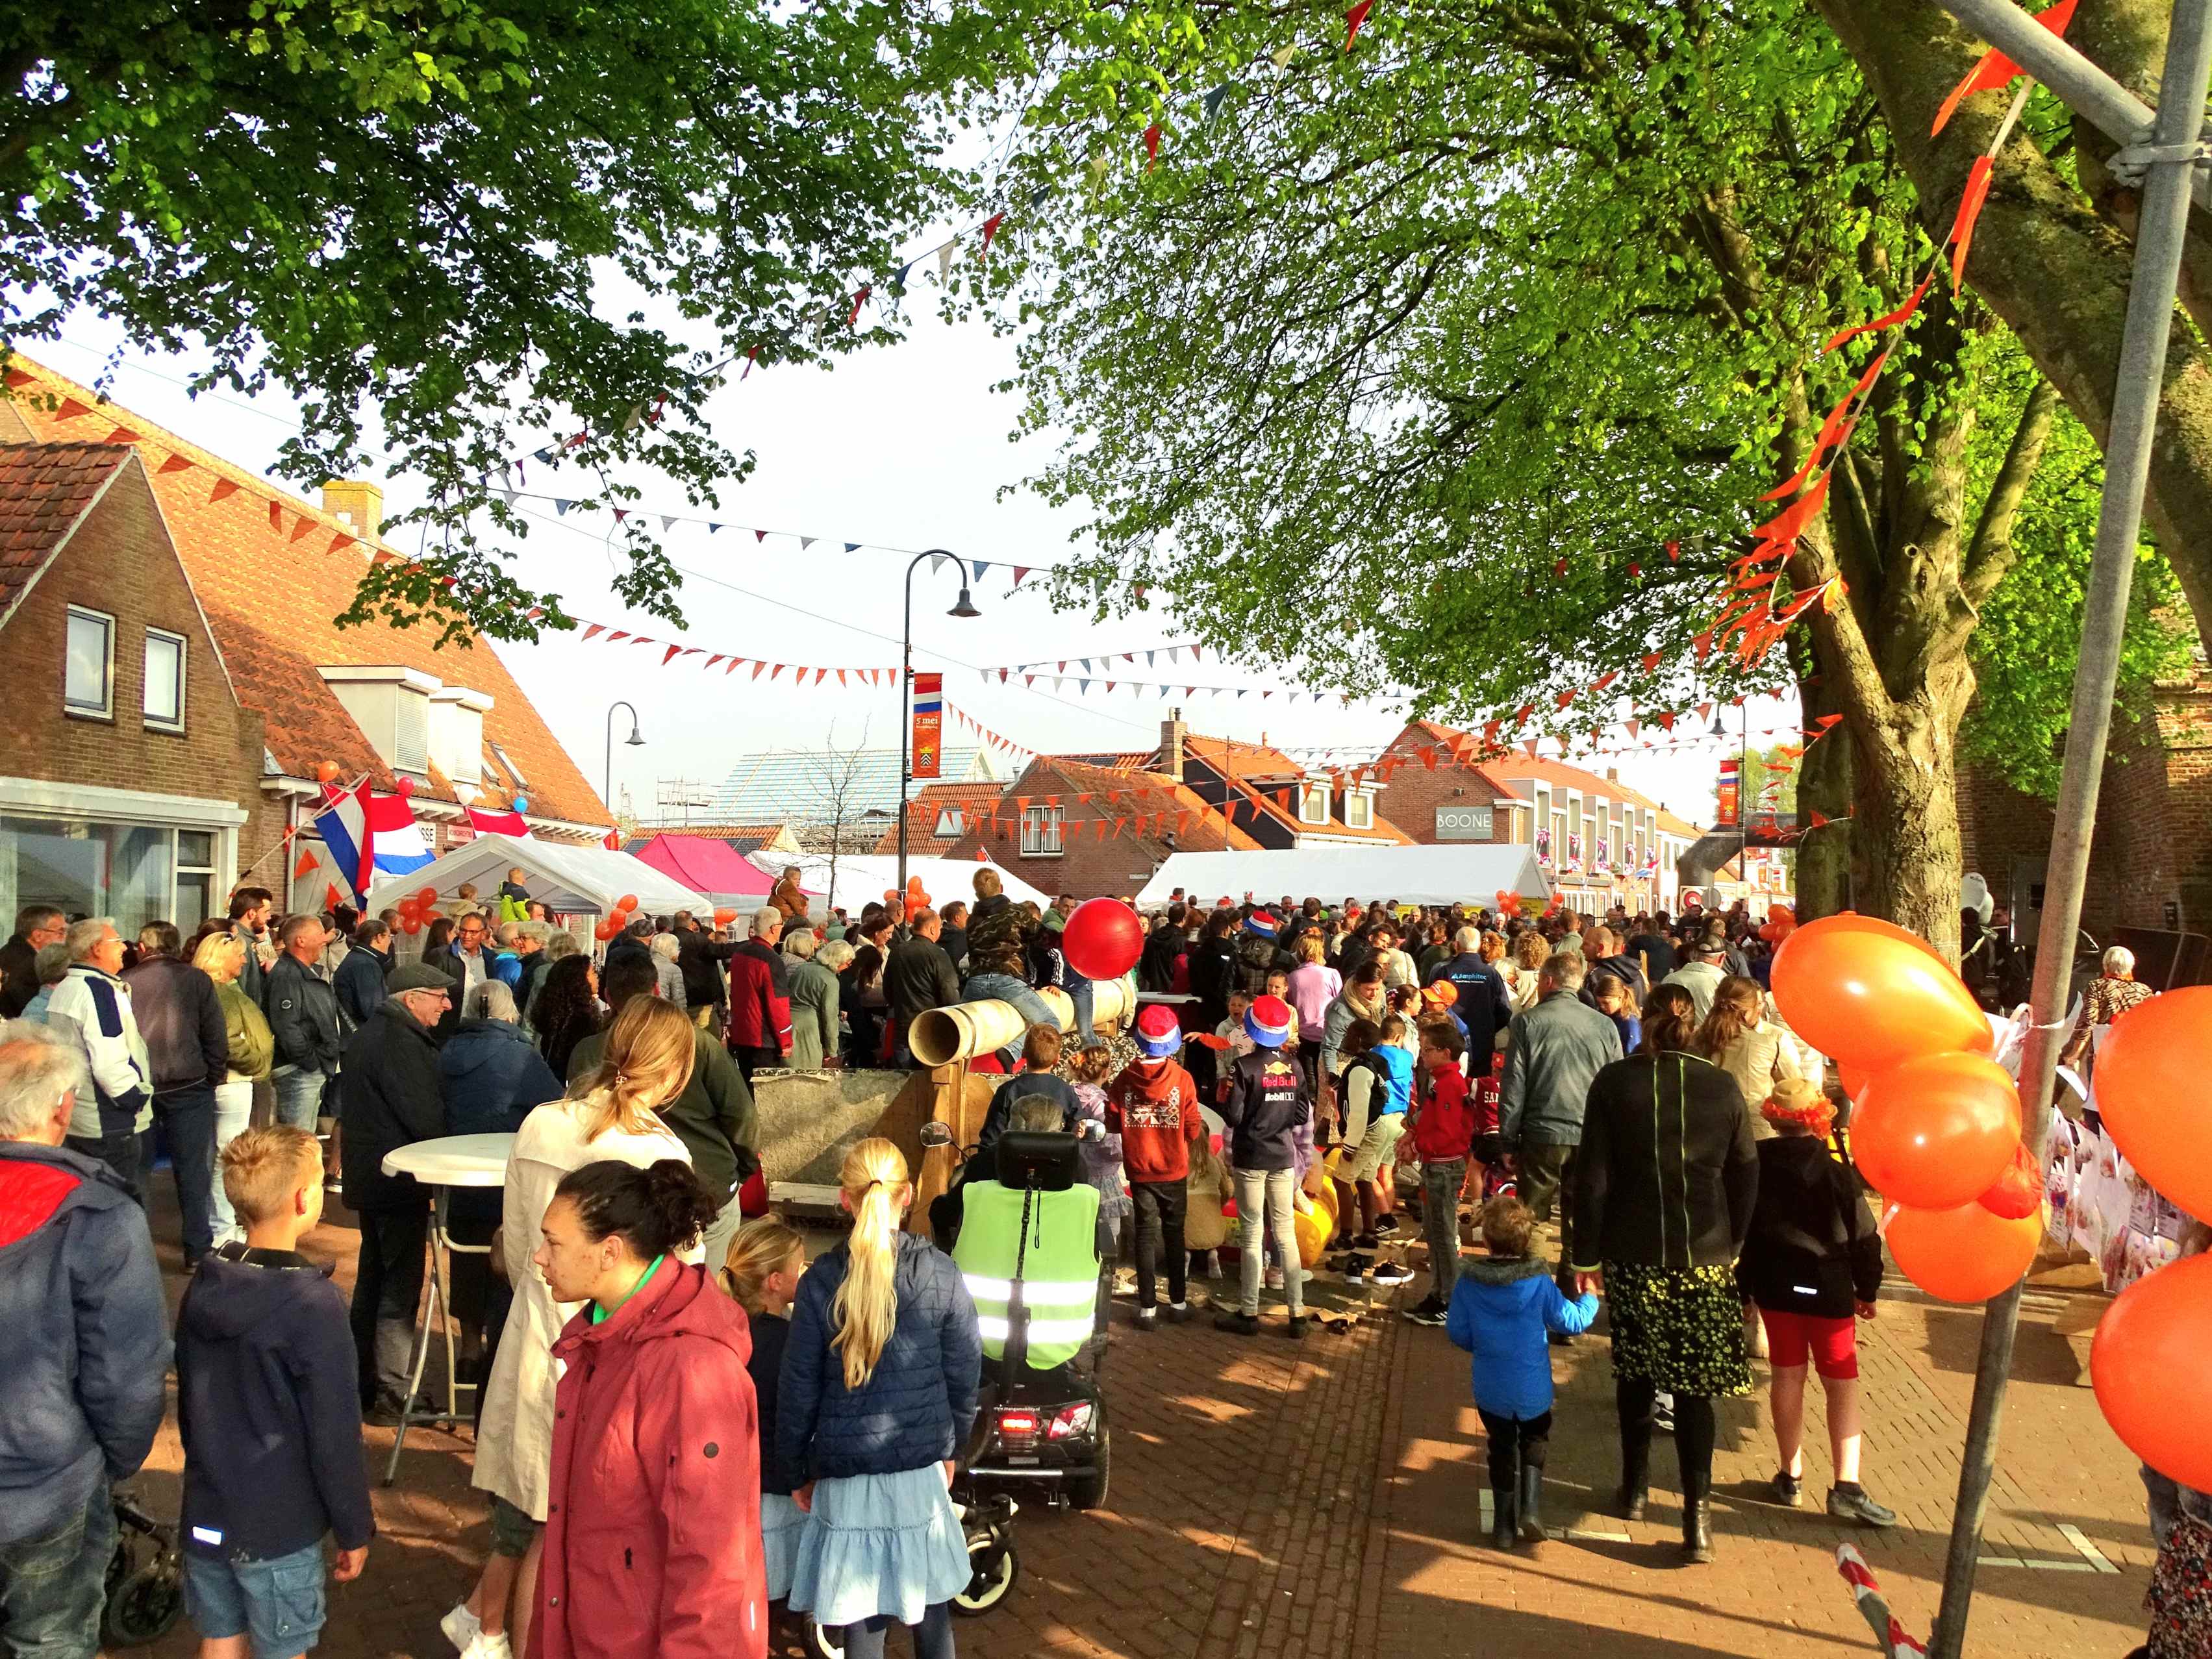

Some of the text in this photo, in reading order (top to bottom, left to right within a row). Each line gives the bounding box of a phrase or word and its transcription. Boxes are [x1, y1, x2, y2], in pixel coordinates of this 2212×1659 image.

[922, 716, 938, 724] mei
[1437, 814, 1492, 828] BOONE
[418, 827, 433, 842] SSE
[1263, 1075, 1296, 1087] Red Bull
[1265, 1092, 1284, 1102] Mobil
